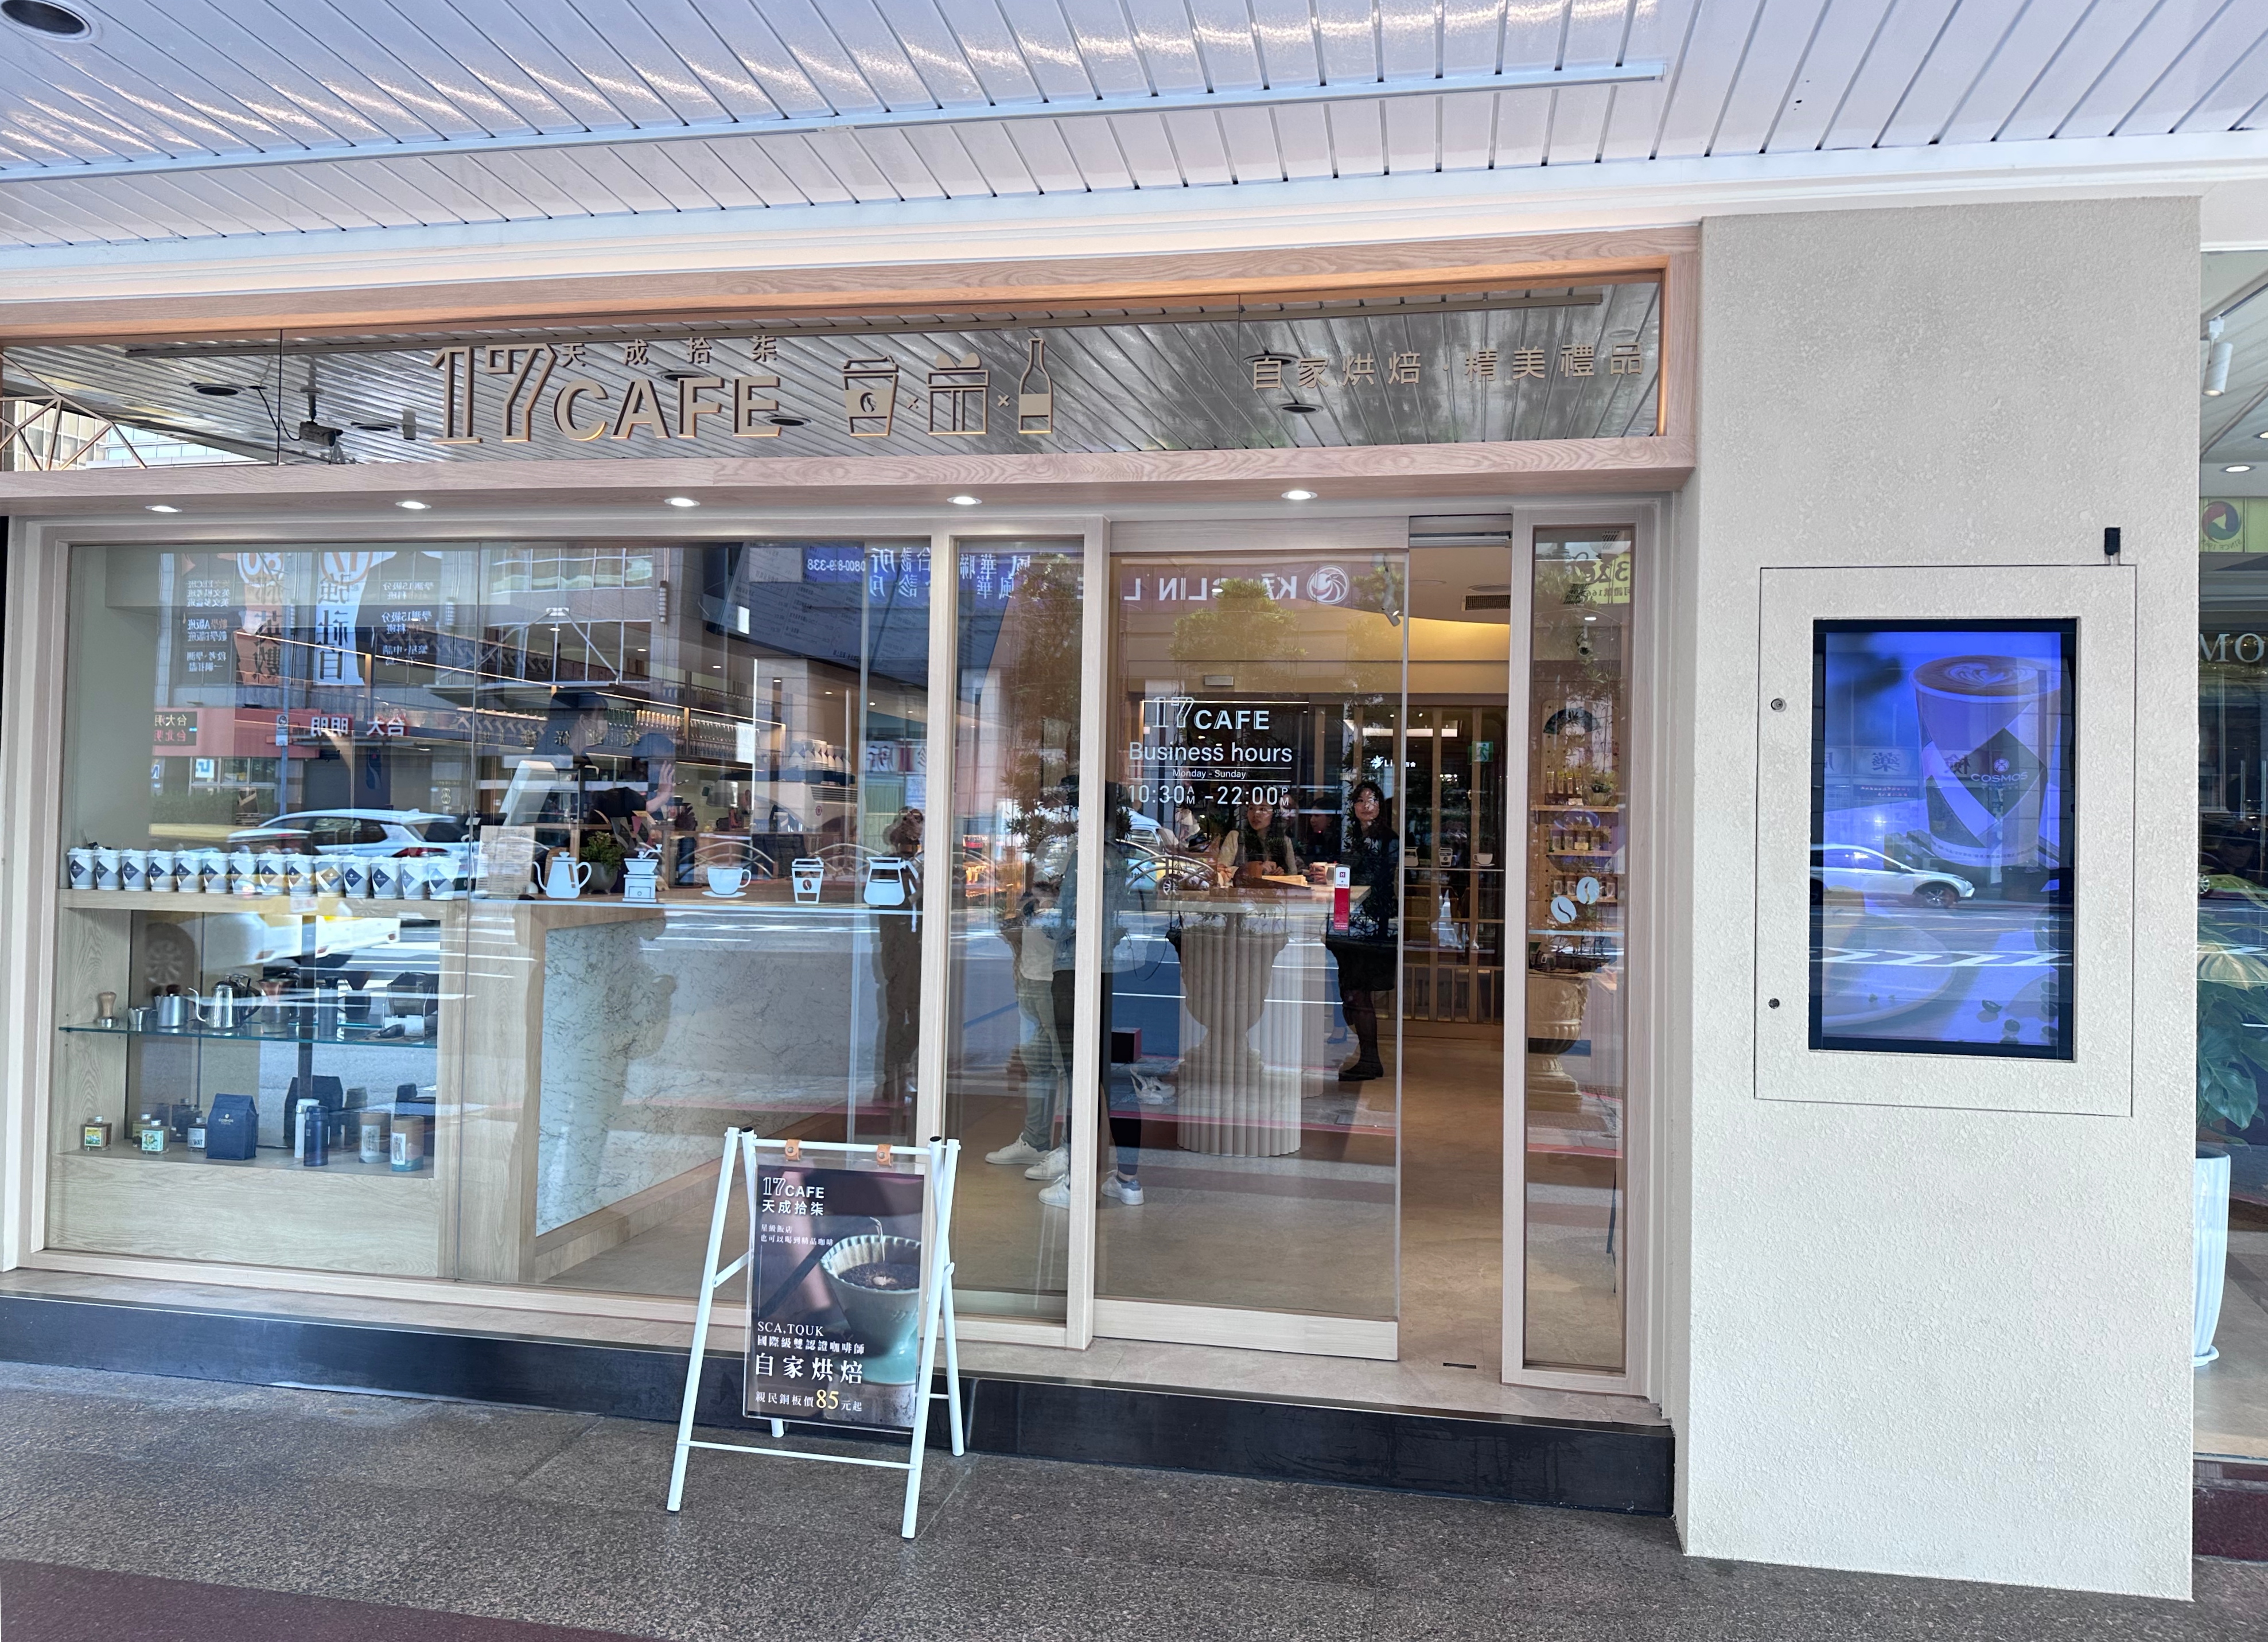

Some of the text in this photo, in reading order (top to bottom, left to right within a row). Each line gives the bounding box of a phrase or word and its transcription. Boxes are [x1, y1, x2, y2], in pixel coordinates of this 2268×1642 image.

[562, 334, 778, 368] 天成拾柒
[1252, 351, 1422, 390] 自家烘焙
[1464, 342, 1645, 382] 精美禮品
[1129, 741, 1293, 762] Business hours
[1172, 769, 1207, 779] Monday
[1214, 769, 1247, 780] Sunday
[1970, 772, 2029, 783] COSMOS
[761, 1199, 824, 1216] 天成拾柒
[757, 1334, 865, 1355] 國際級雙認證咖啡師
[755, 1352, 863, 1384] 自家烘焙
